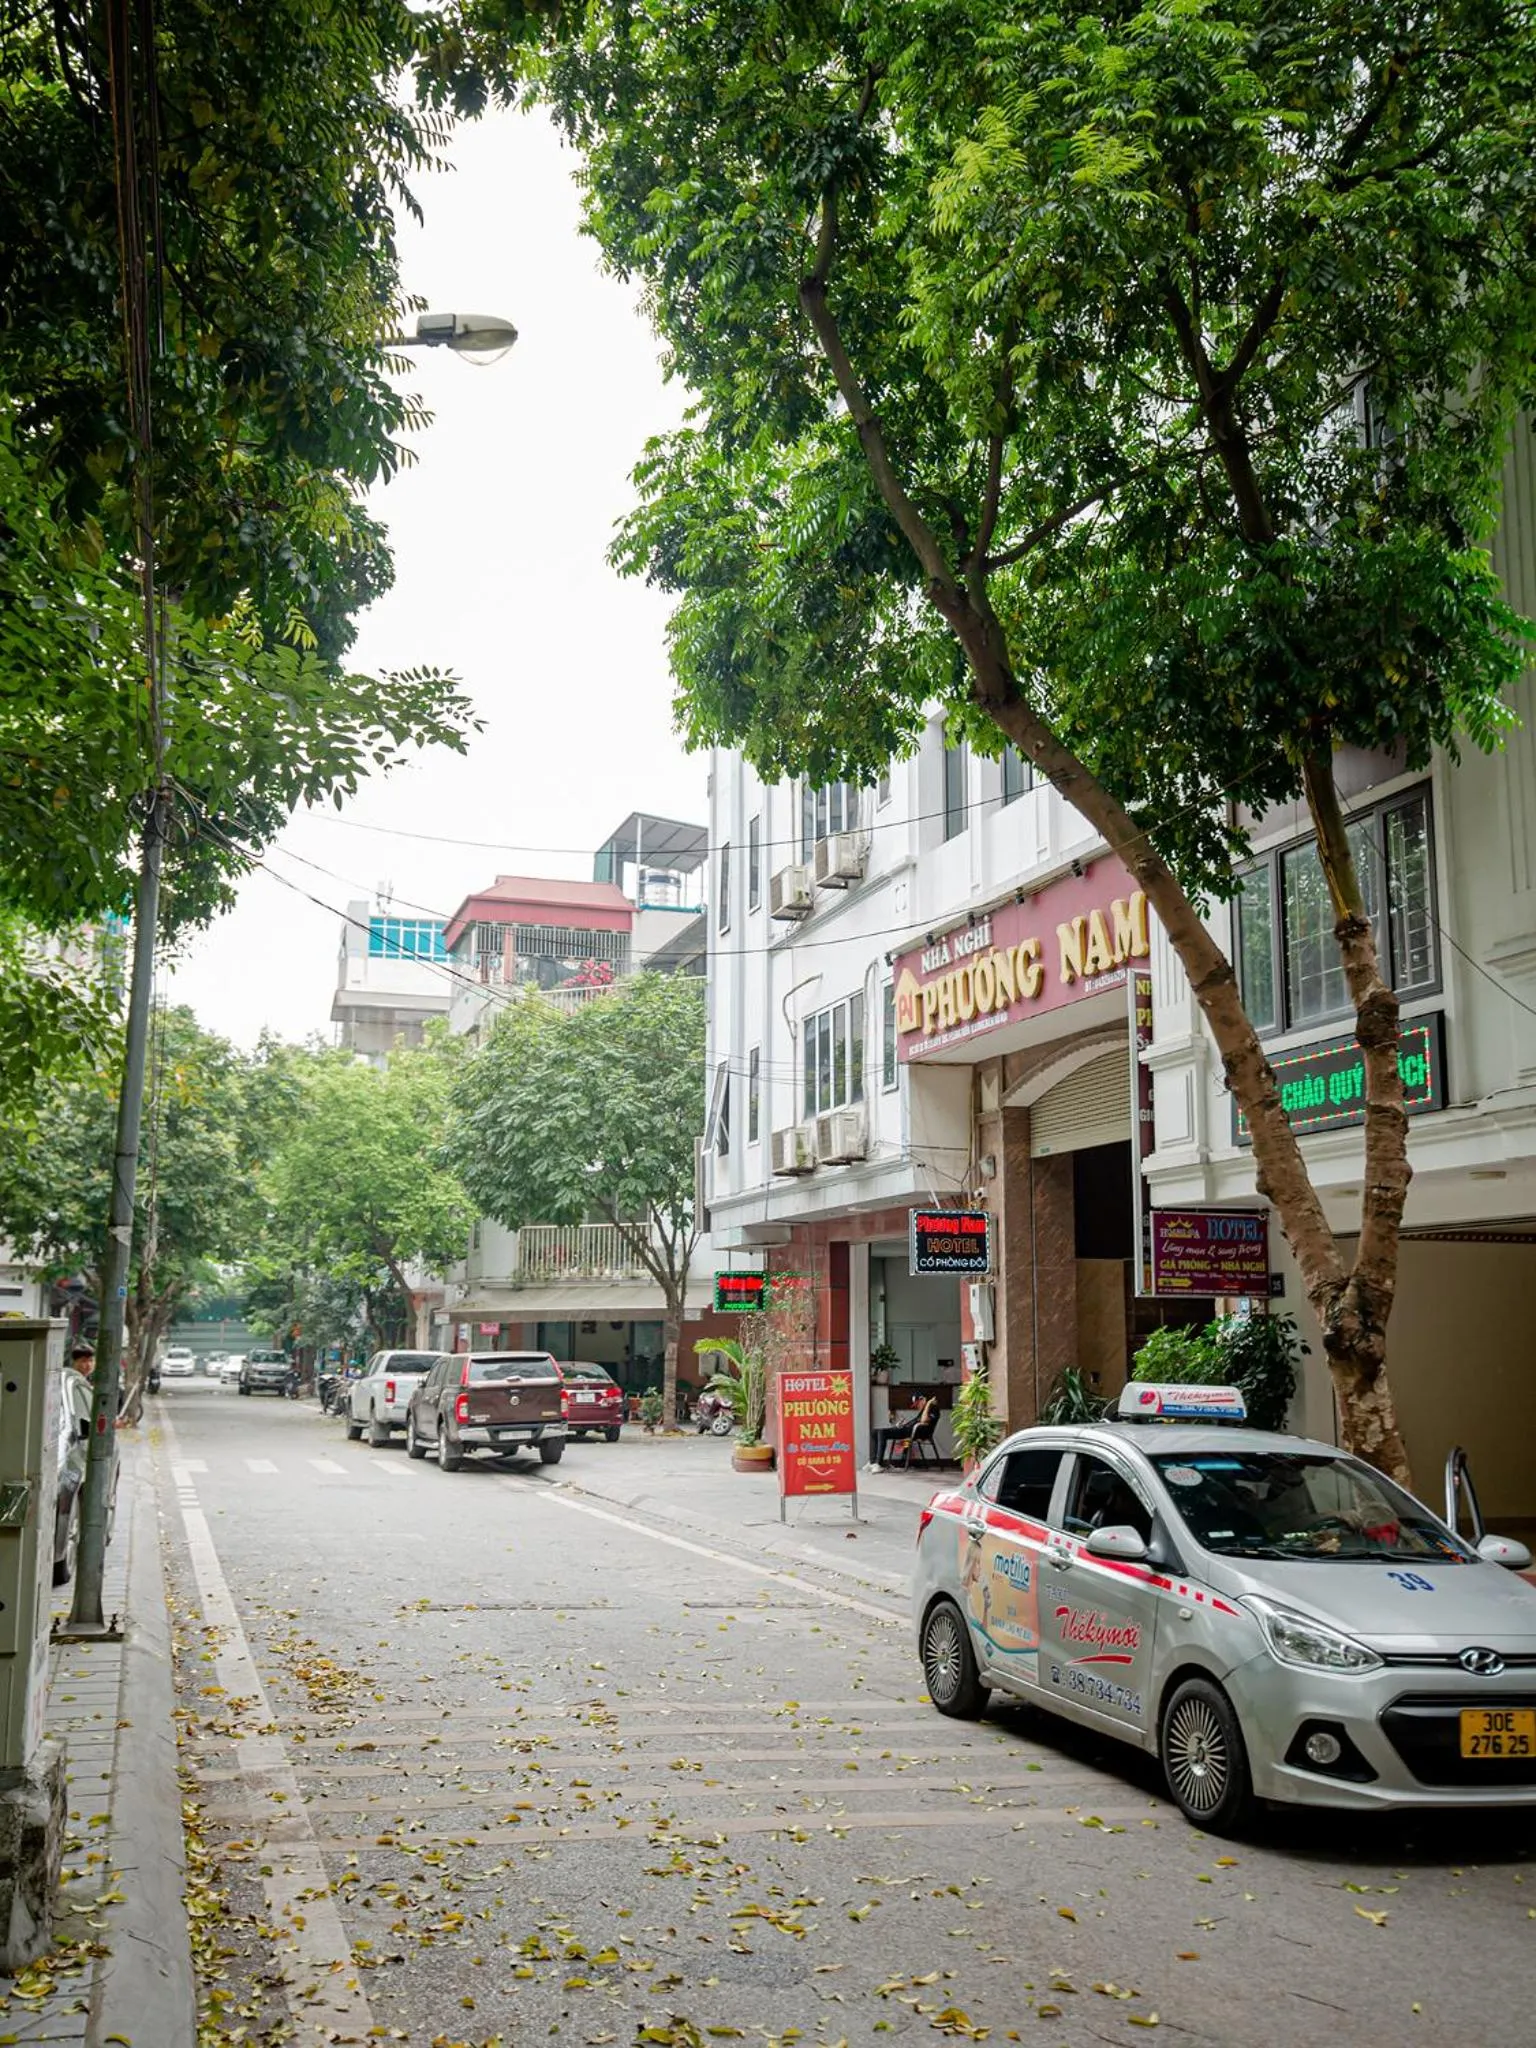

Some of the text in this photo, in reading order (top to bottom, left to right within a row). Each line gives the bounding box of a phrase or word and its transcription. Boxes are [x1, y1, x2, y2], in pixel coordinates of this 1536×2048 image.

[921, 936, 951, 974] NHÀ
[921, 938, 1044, 1035] PHƯƠNG
[1056, 890, 1148, 984] NAM
[1329, 1062, 1364, 1105] QUÝ
[1205, 1219, 1264, 1241] HOTEL
[927, 1237, 980, 1254] HOTEL
[919, 1256, 935, 1268] CÓ
[936, 1256, 969, 1268] PHÒNG
[784, 1378, 829, 1392] HOTEL
[784, 1398, 850, 1417] PHƯƠNG
[800, 1422, 836, 1439] NAM
[1387, 1572, 1434, 1591] 39
[1483, 1712, 1516, 1732] 30E
